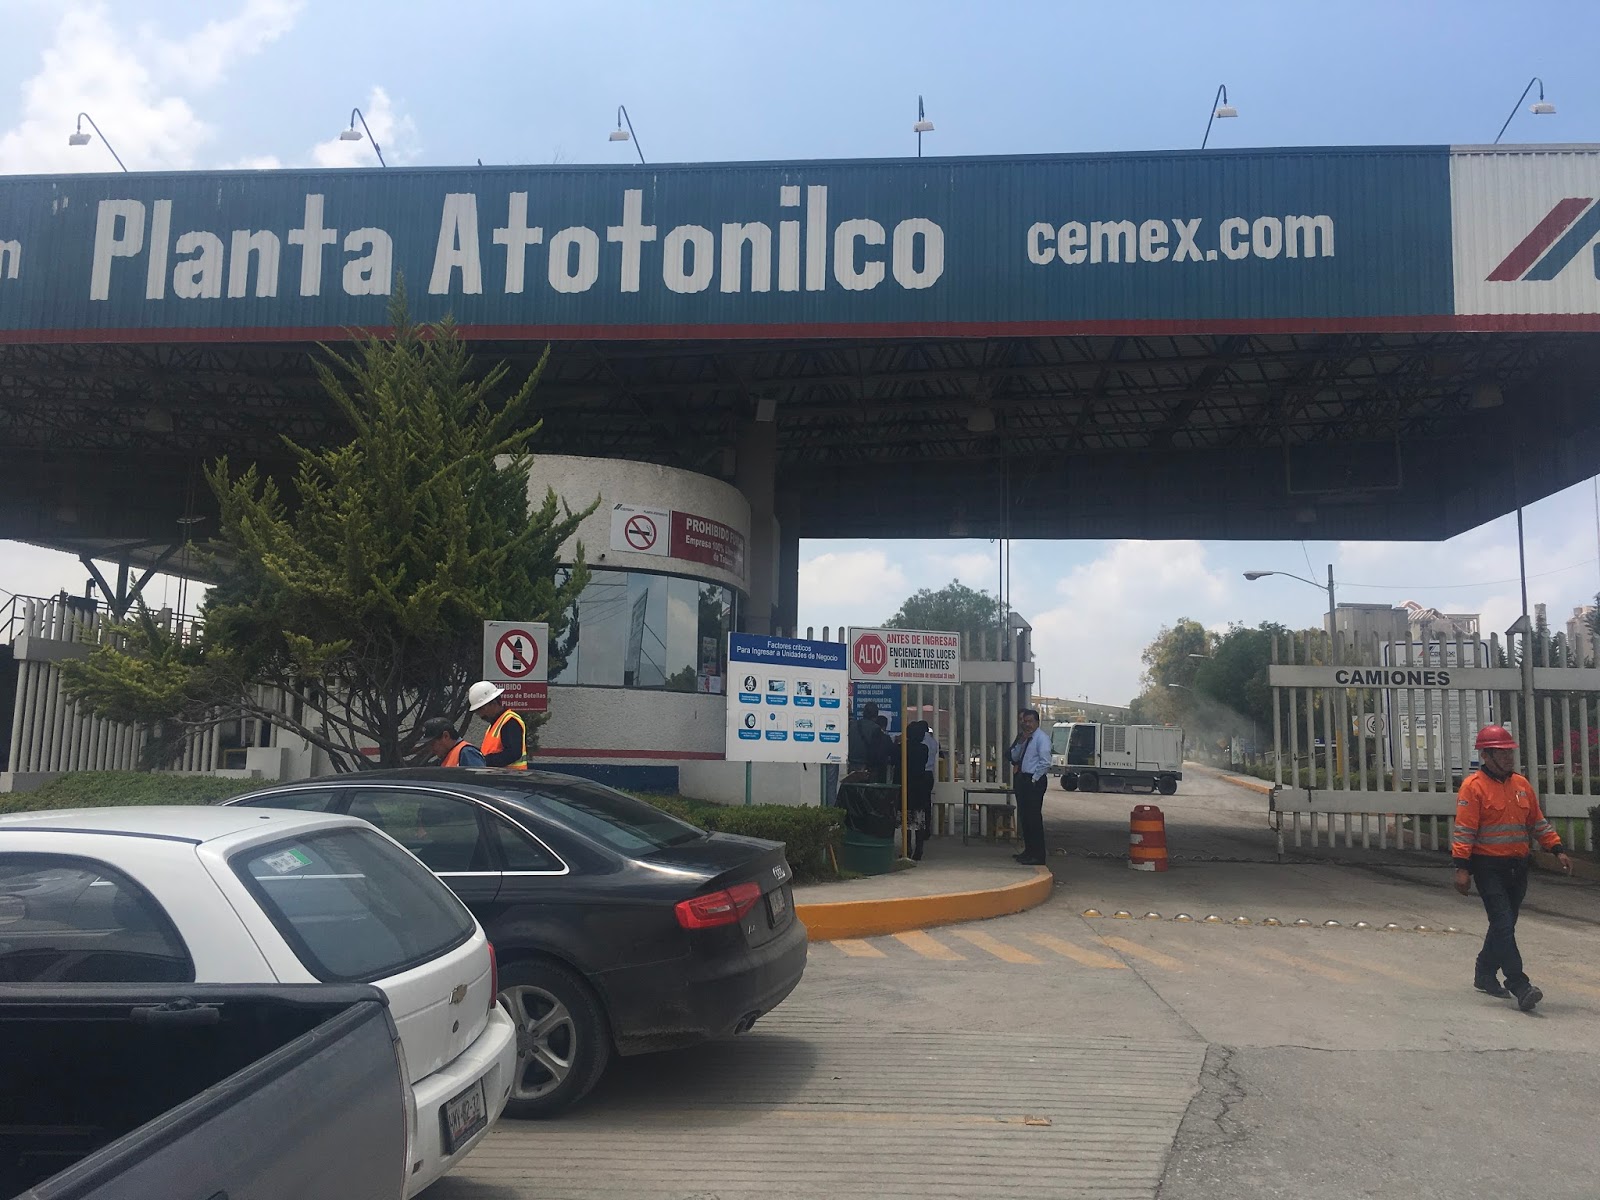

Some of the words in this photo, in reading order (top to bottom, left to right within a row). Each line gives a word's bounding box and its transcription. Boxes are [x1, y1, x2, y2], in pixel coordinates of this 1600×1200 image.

[90, 193, 394, 300] Planta
[428, 184, 945, 295] Atotonilco
[1026, 214, 1336, 266] cemex.com
[686, 517, 729, 542] PROHIBIDO
[685, 534, 712, 549] Empresa
[767, 640, 792, 650] Factores
[886, 633, 910, 645] ANTES
[911, 635, 921, 645] DE
[922, 635, 958, 647] INGRESAR
[736, 645, 751, 654] Para
[751, 647, 776, 657] Ingresar
[781, 650, 807, 659] Unidades
[807, 652, 815, 660] de
[816, 653, 838, 662] Negocio
[859, 644, 883, 665] ALTO
[889, 647, 921, 658] ENCIENDE
[922, 648, 935, 659] TUS
[936, 649, 956, 660] LUCES
[894, 659, 899, 668] E
[900, 659, 950, 670] INTERMITENTES
[1335, 669, 1451, 686] CAMIONES
